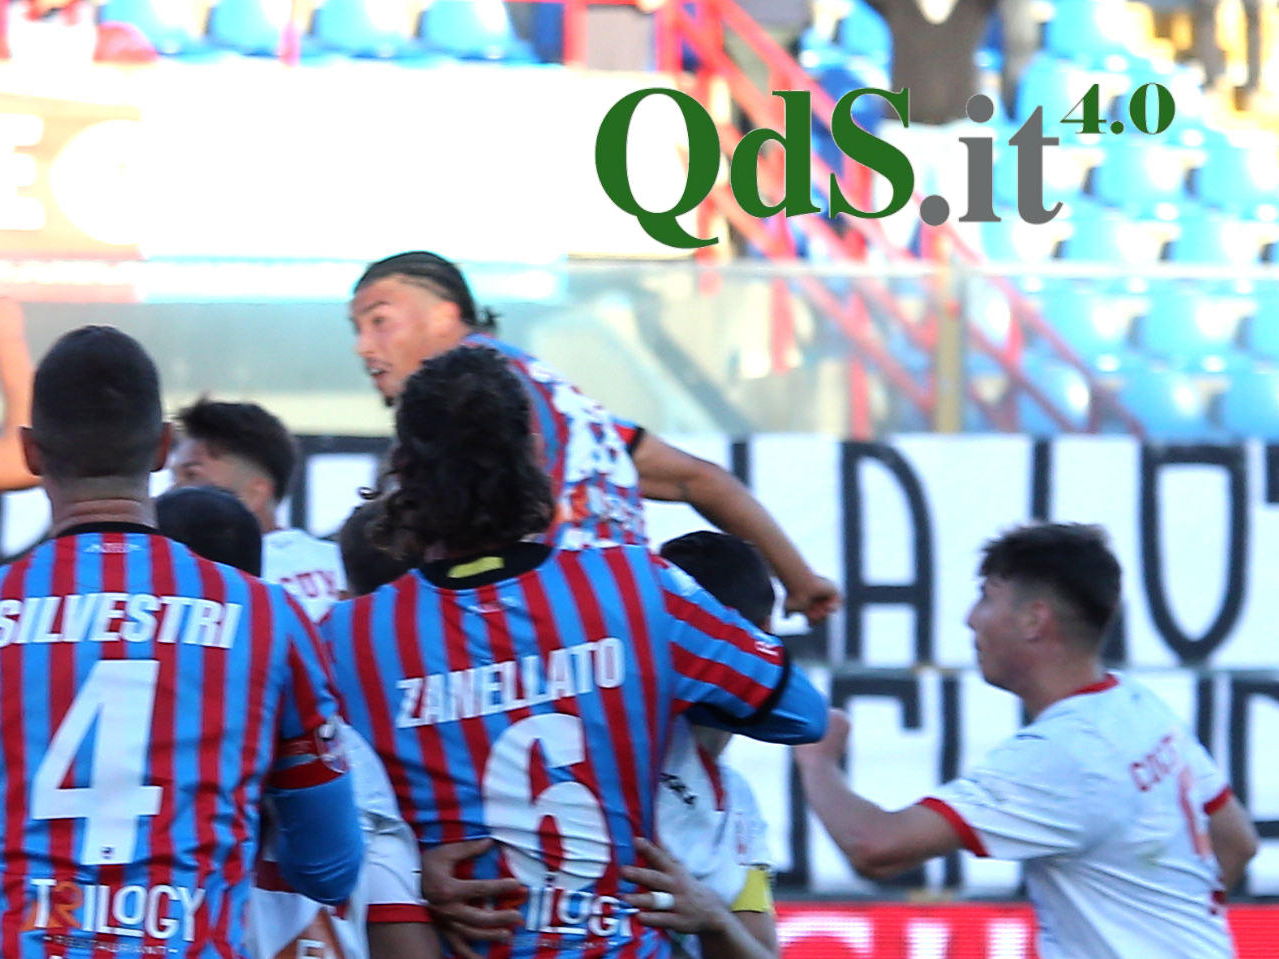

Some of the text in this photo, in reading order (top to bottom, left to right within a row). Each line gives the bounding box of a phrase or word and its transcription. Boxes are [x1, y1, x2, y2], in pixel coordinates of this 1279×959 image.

[395, 636, 626, 729] ZANELLATO
[32, 660, 163, 867] 4
[482, 712, 612, 888] 6
[22, 878, 207, 942] TRILOGY
